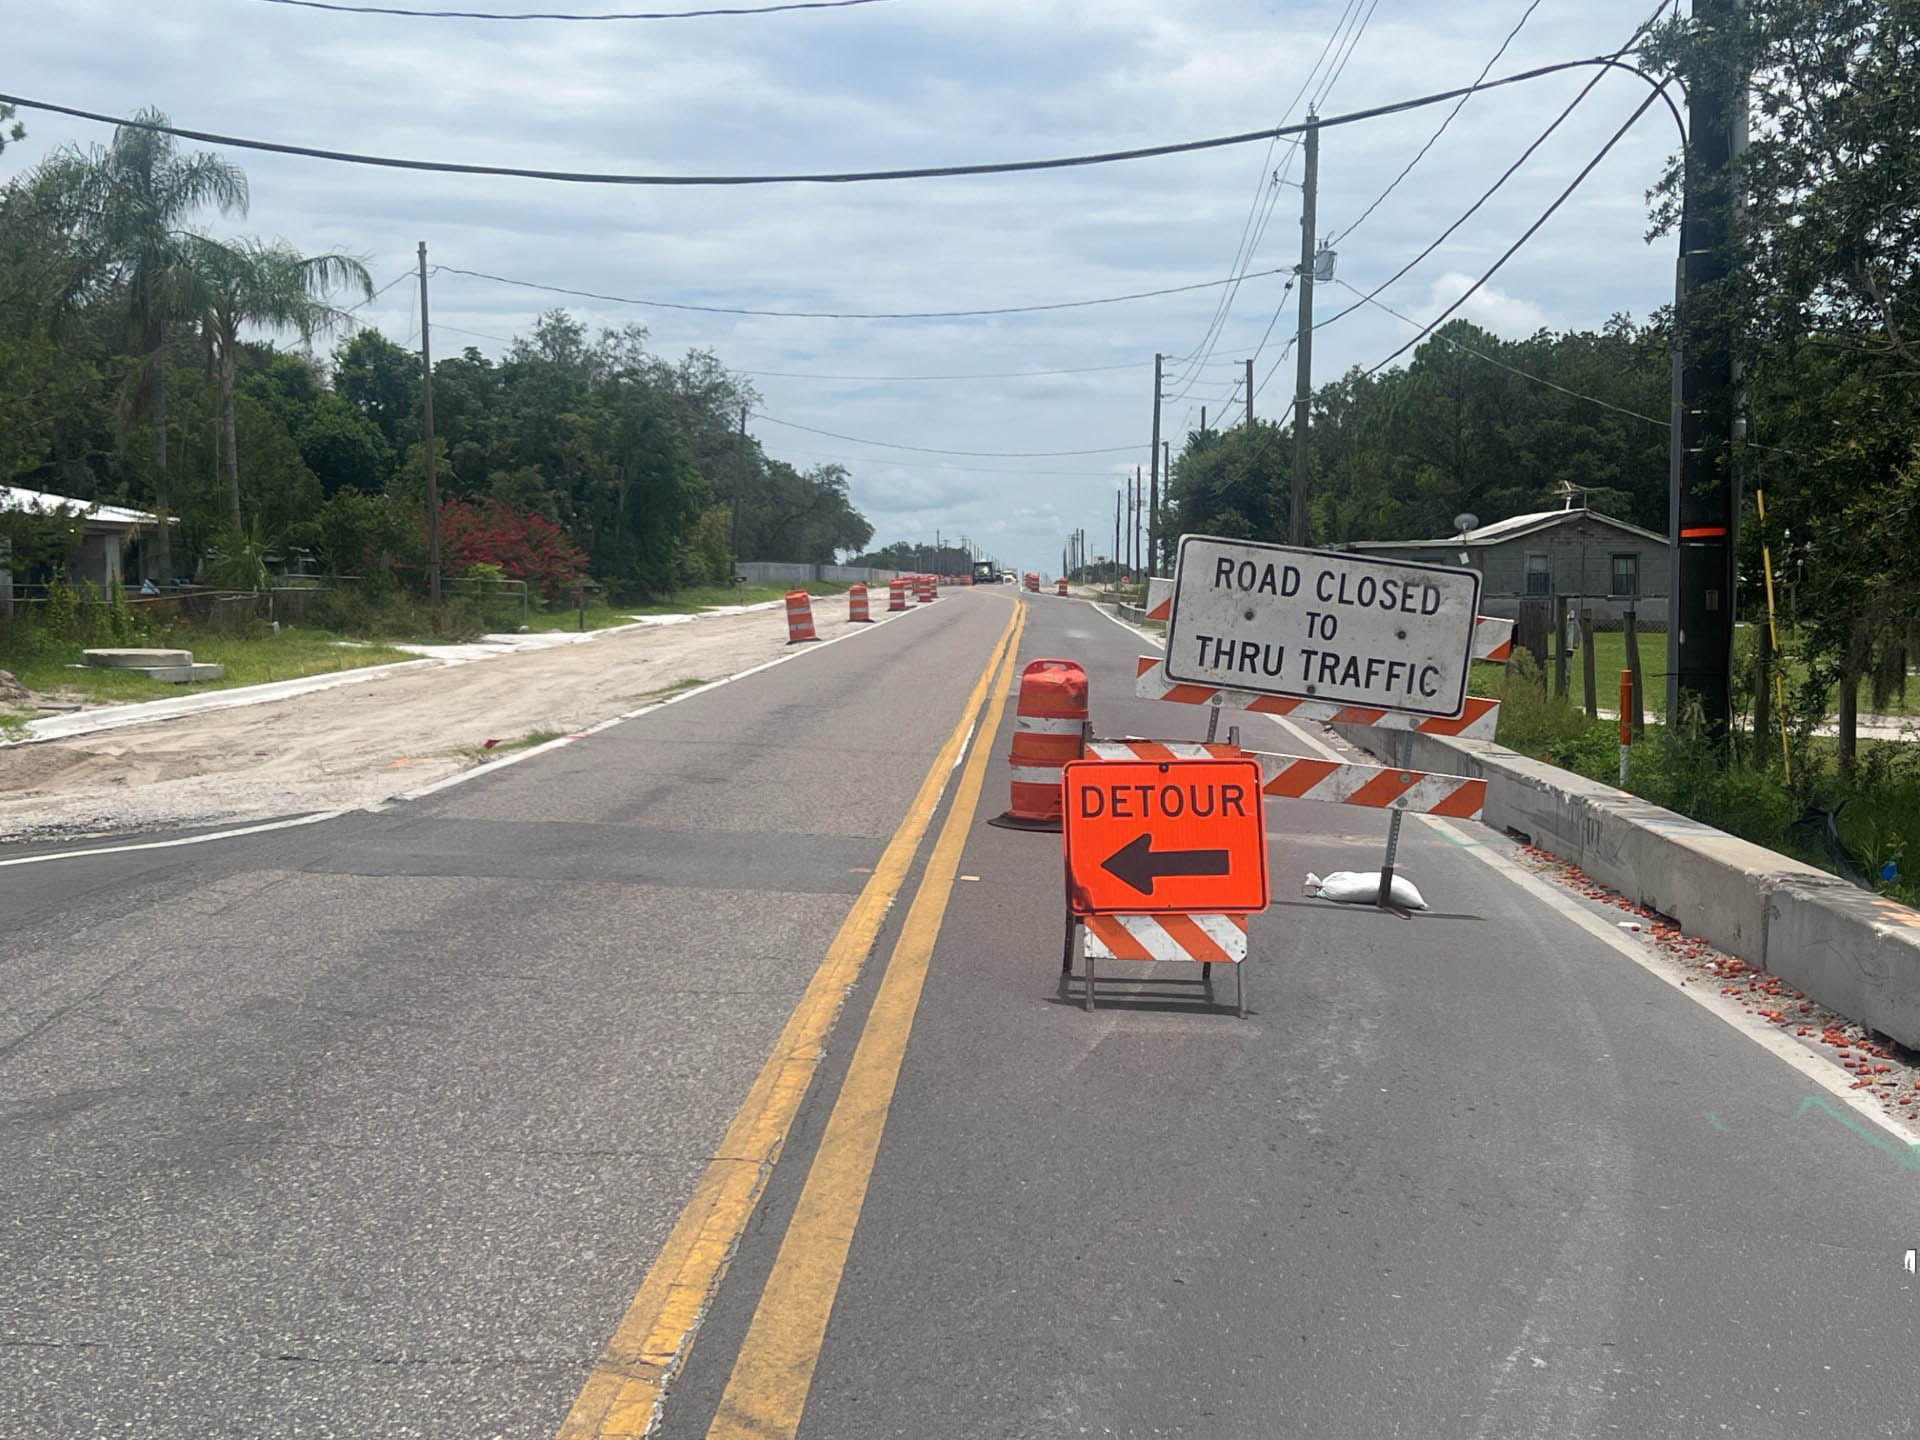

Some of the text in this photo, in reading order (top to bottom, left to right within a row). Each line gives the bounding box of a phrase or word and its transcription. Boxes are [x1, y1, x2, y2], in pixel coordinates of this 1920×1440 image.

[1214, 556, 1441, 616] ROAD CLOSED
[1305, 611, 1338, 641] TO
[1195, 634, 1440, 698] THRU TRAFFIC
[1081, 785, 1246, 819] DETOUR
